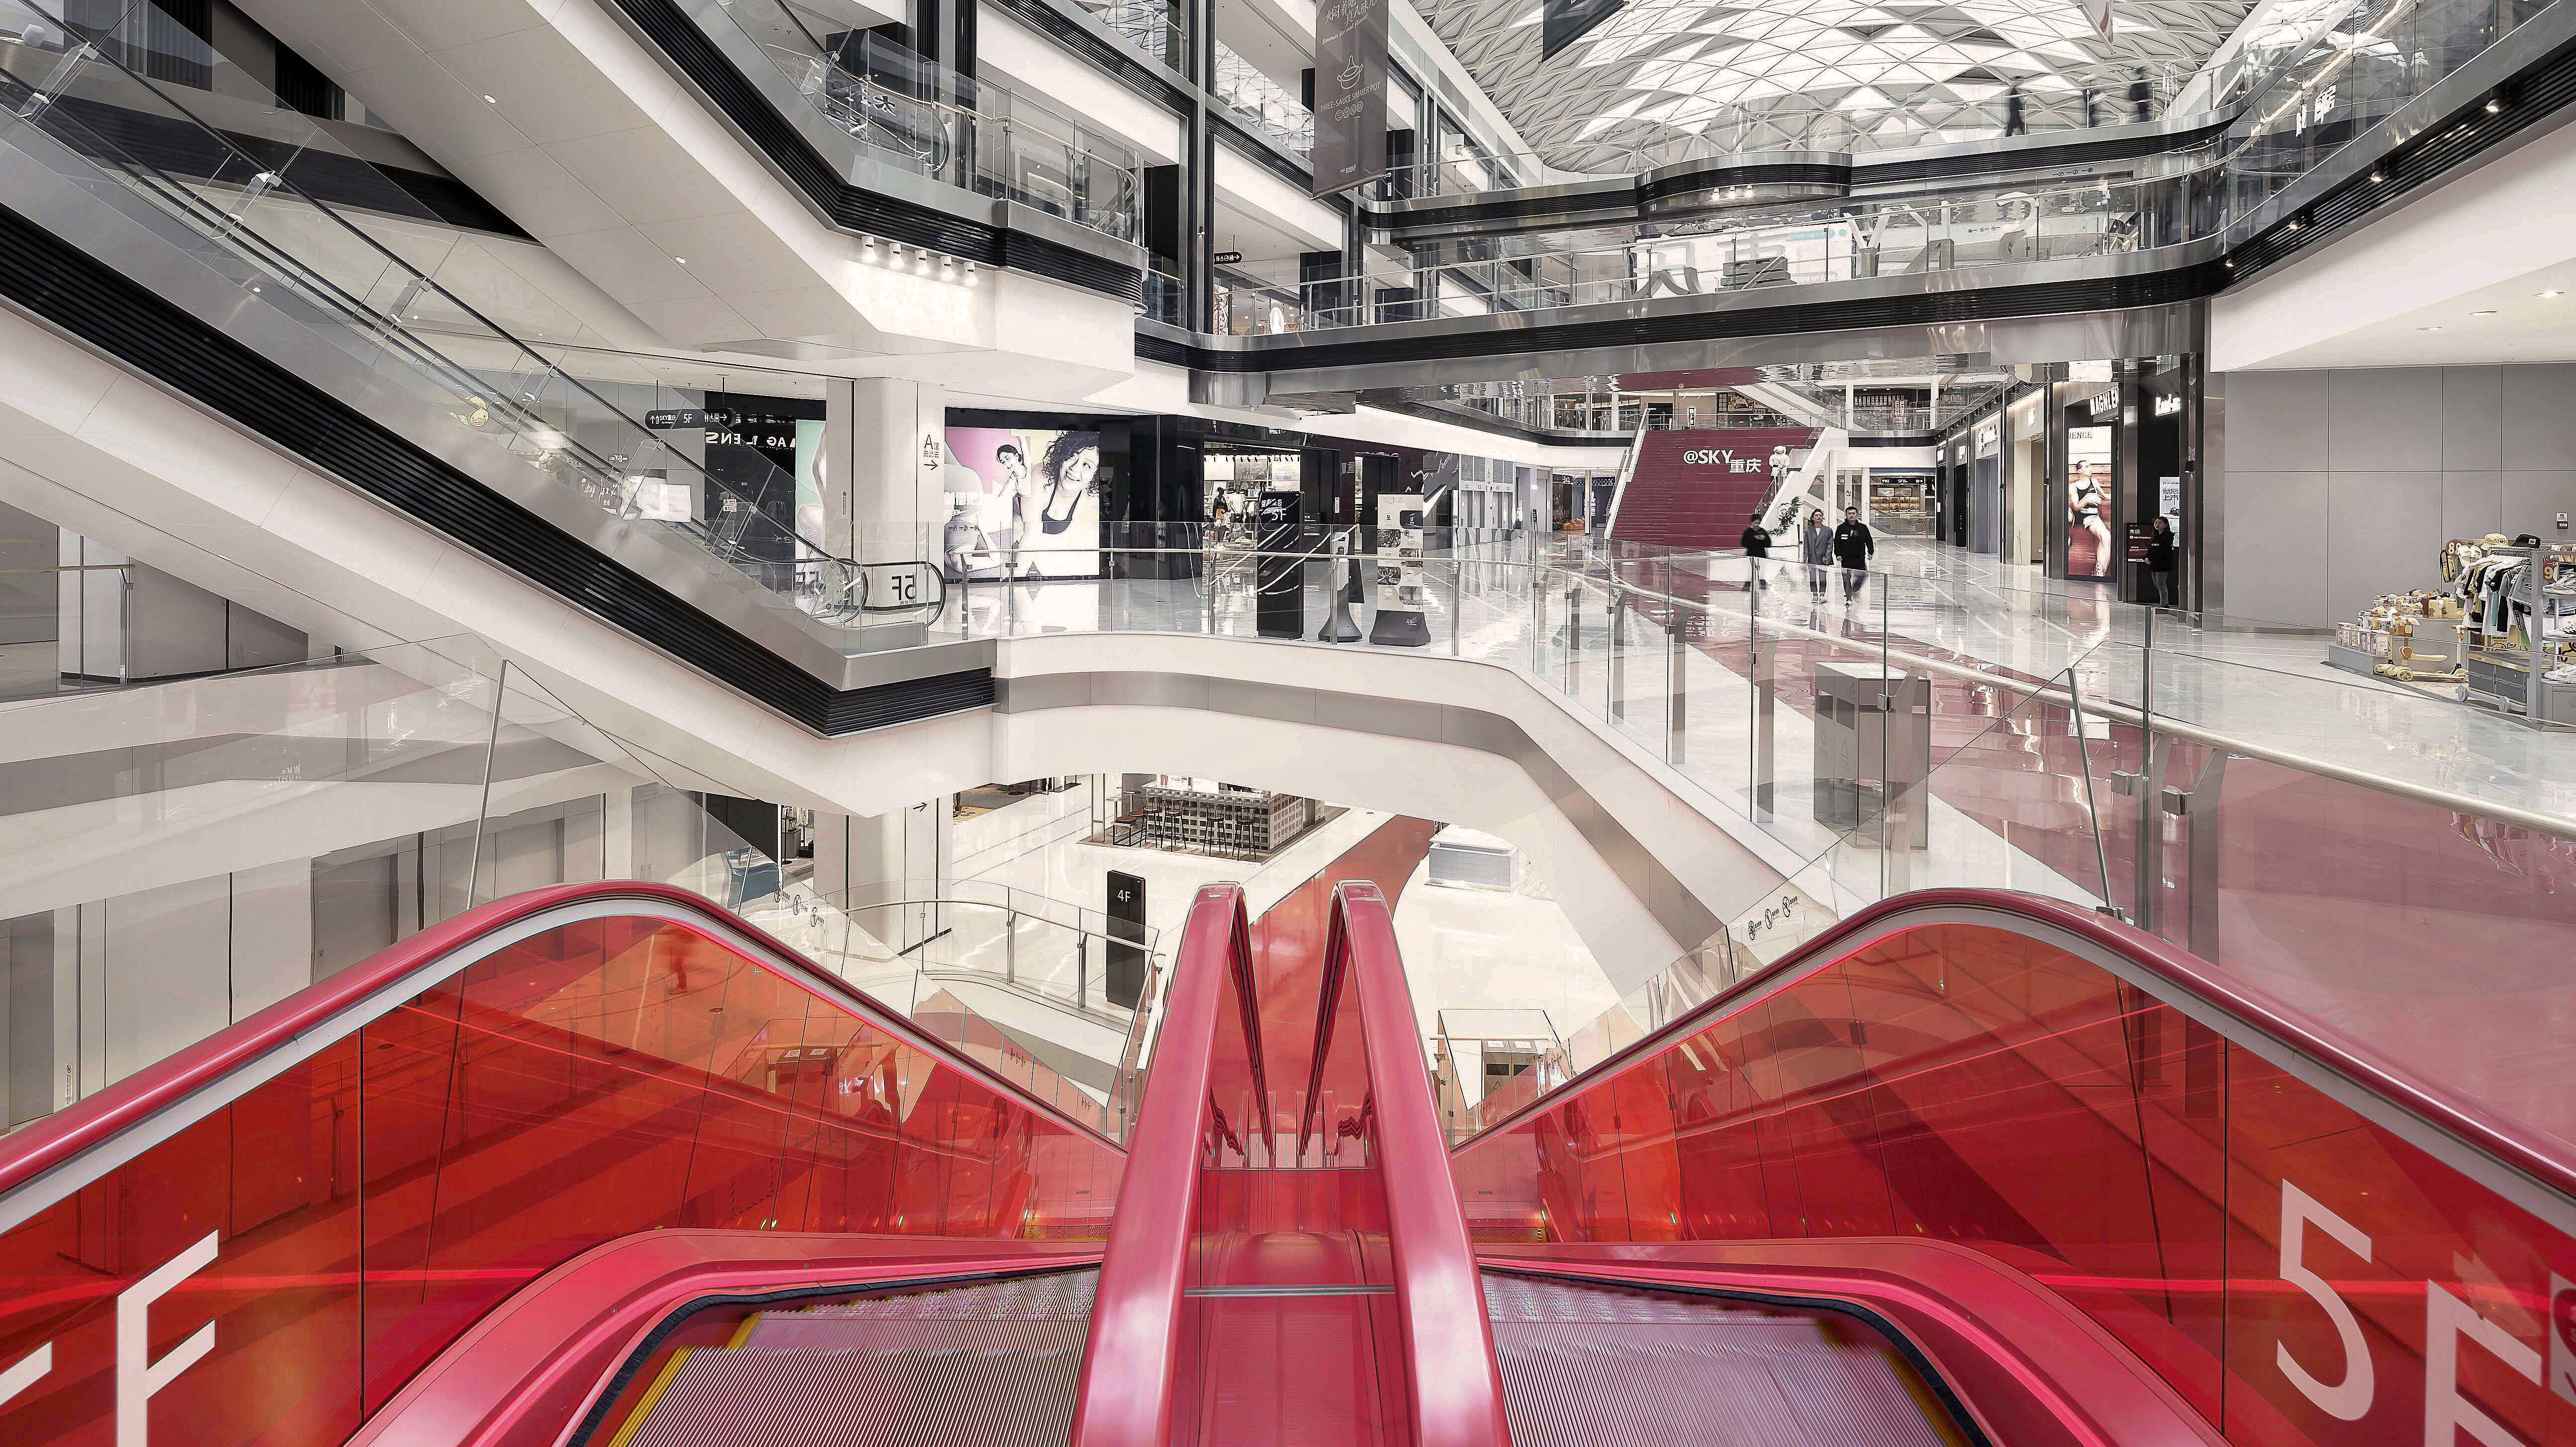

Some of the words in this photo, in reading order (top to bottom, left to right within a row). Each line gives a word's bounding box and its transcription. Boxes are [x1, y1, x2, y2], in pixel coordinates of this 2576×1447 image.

[1320, 95, 1351, 112] THREE-SAUCE
[1351, 86, 1369, 100] SIMMER
[1370, 82, 1381, 92] POT
[683, 414, 692, 423] 5F
[1117, 889, 1131, 902] 4F
[2277, 1178, 2542, 1447] 5F
